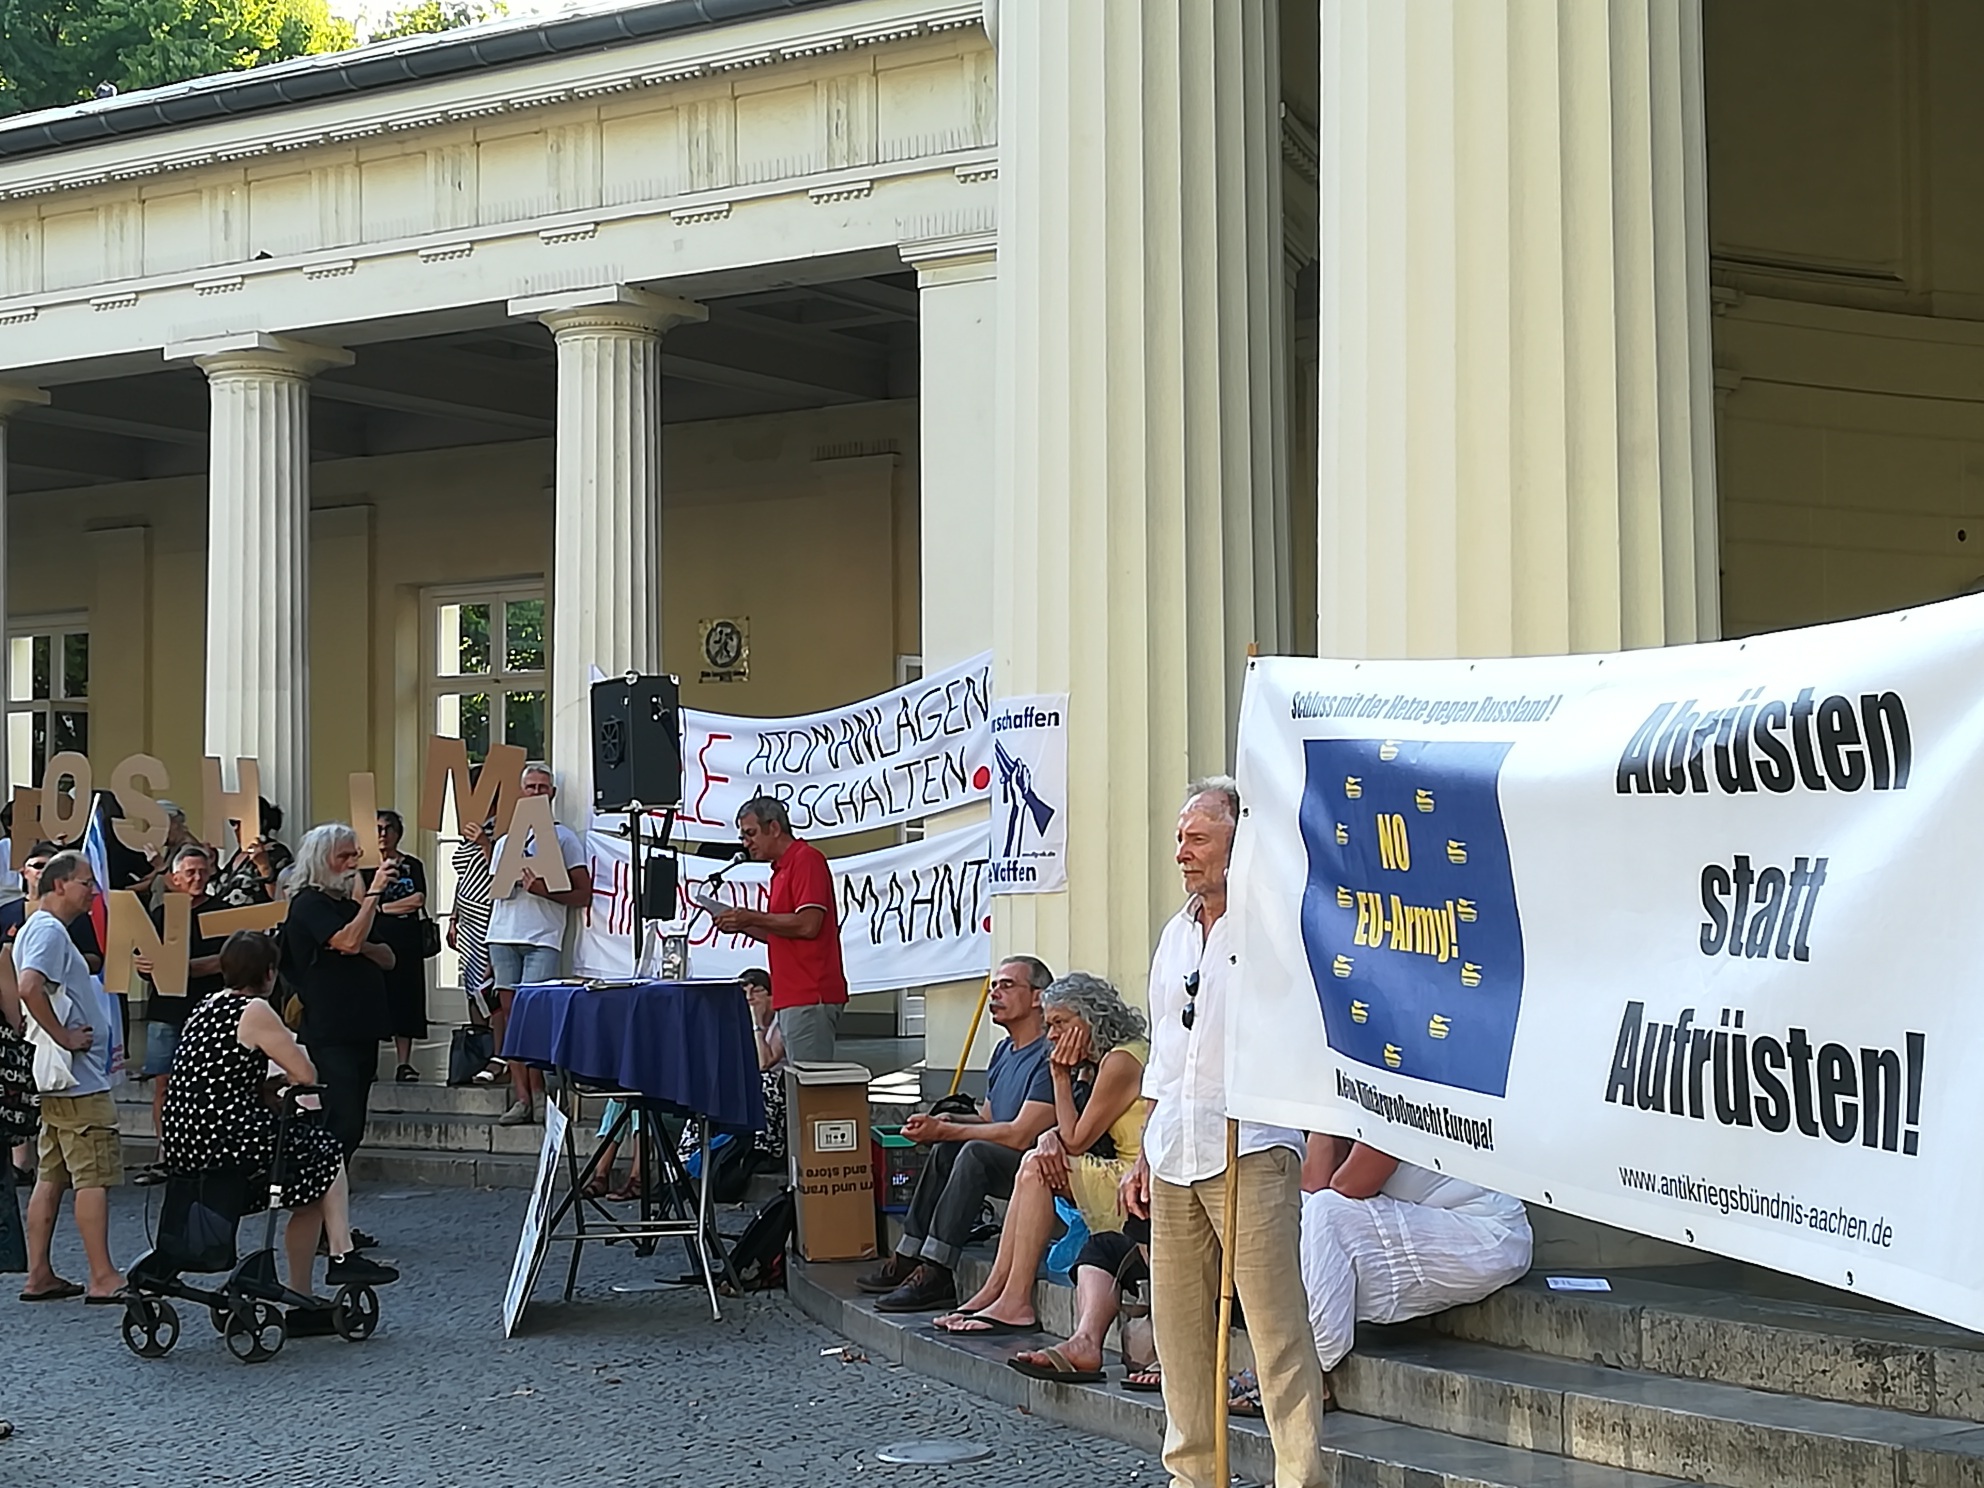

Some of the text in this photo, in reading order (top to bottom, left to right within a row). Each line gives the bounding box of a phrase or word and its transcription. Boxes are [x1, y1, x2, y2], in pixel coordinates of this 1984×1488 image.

[746, 666, 989, 774] ATOMANLAGEN
[1291, 690, 1337, 720] Schluss
[1333, 692, 1363, 719] mit
[1357, 693, 1391, 720] der
[1384, 695, 1430, 722] Hetze
[1422, 700, 1478, 726] gegen
[1615, 685, 1912, 795] Abrüsten
[1376, 813, 1411, 872] NO
[1353, 891, 1459, 963] EU-Army!
[1699, 854, 1829, 962] statt
[1604, 1000, 1925, 1157] Aufrüsten!
[1442, 1107, 1495, 1152] Europa!
[806, 1165, 867, 1178] and store
[832, 1182, 857, 1195] und
[1618, 1166, 1894, 1248] www.antikriegsbündnis-aachen.de
